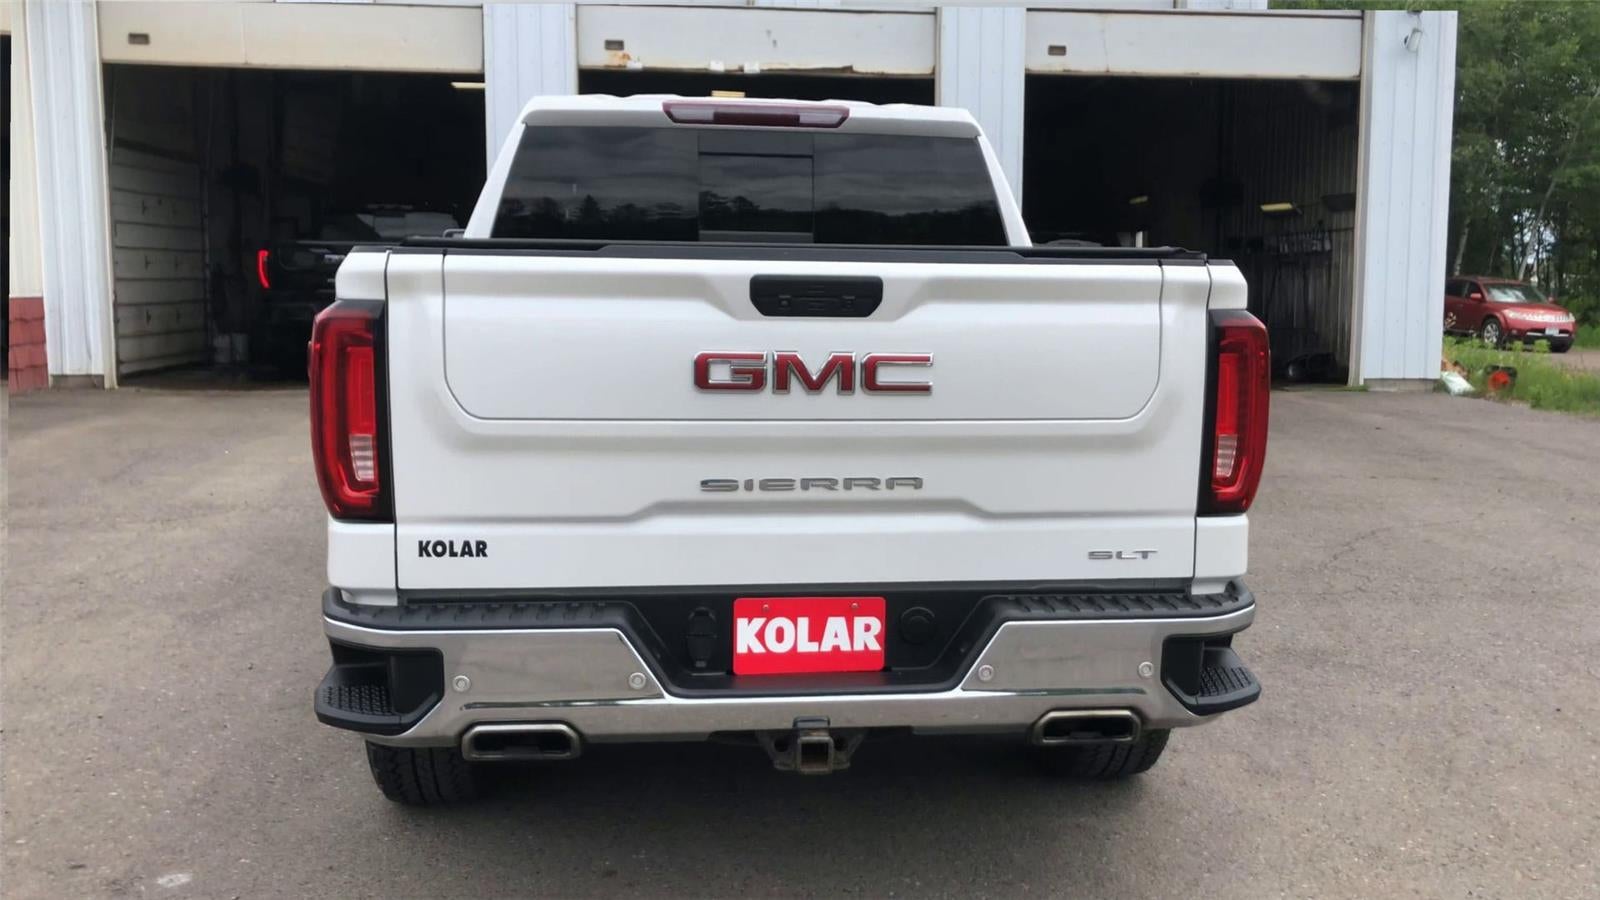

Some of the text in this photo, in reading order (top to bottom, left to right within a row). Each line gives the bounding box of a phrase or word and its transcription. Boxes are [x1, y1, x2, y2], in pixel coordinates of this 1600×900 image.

[693, 351, 933, 395] GMC
[699, 476, 924, 492] SIERRA
[418, 539, 488, 558] KOLAR
[1088, 549, 1158, 560] SLT
[736, 616, 882, 654] KOLAR
